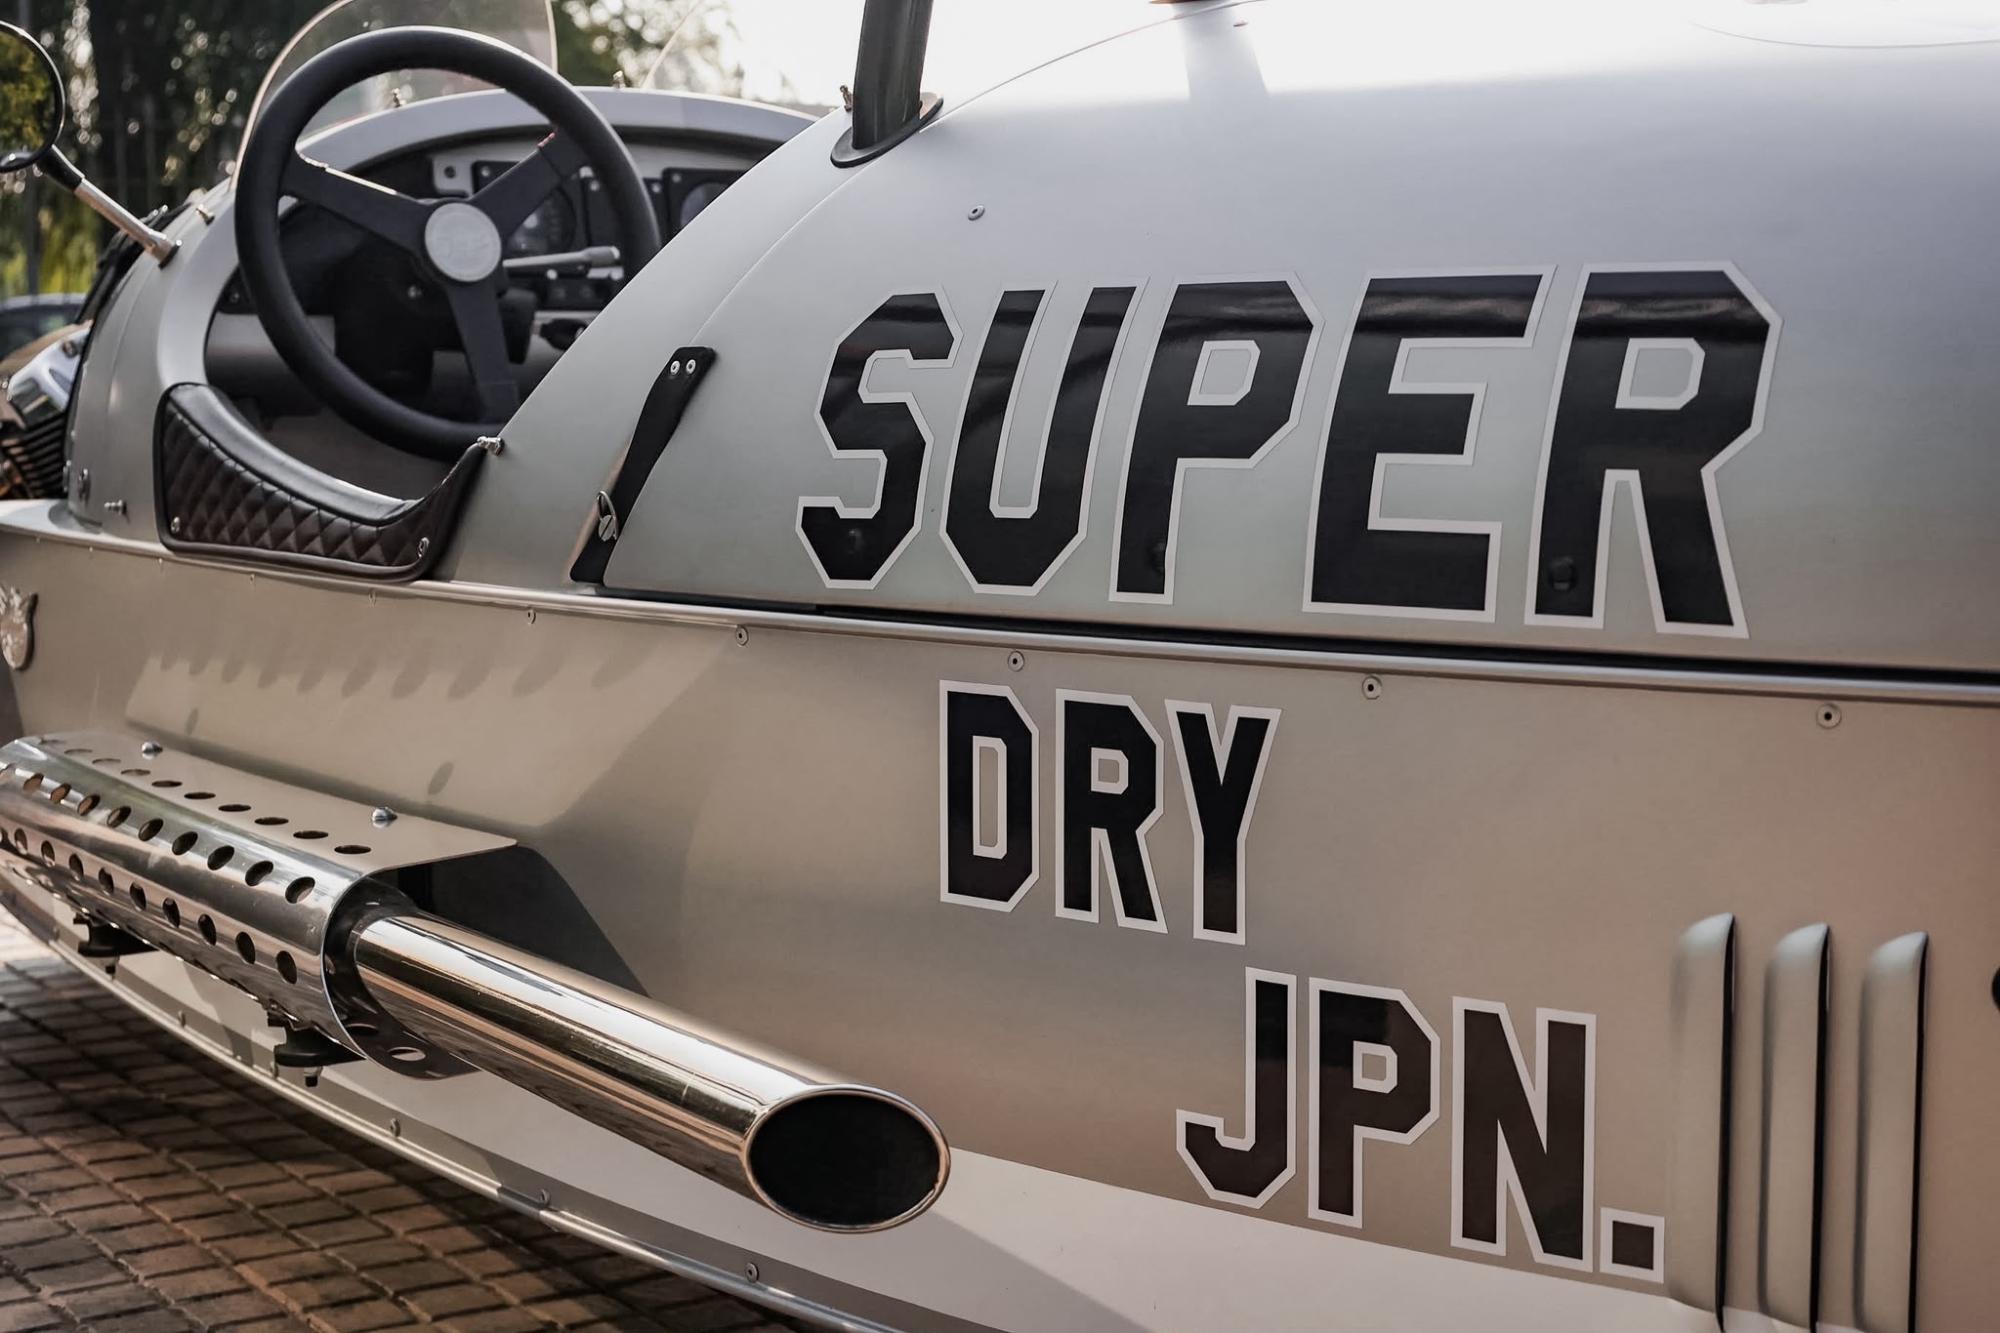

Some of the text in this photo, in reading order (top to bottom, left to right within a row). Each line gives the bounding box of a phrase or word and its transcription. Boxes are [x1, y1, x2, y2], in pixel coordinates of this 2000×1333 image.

[796, 262, 1783, 638] SUPER
[940, 680, 1281, 945] DRY
[1177, 967, 1664, 1283] JPN.
